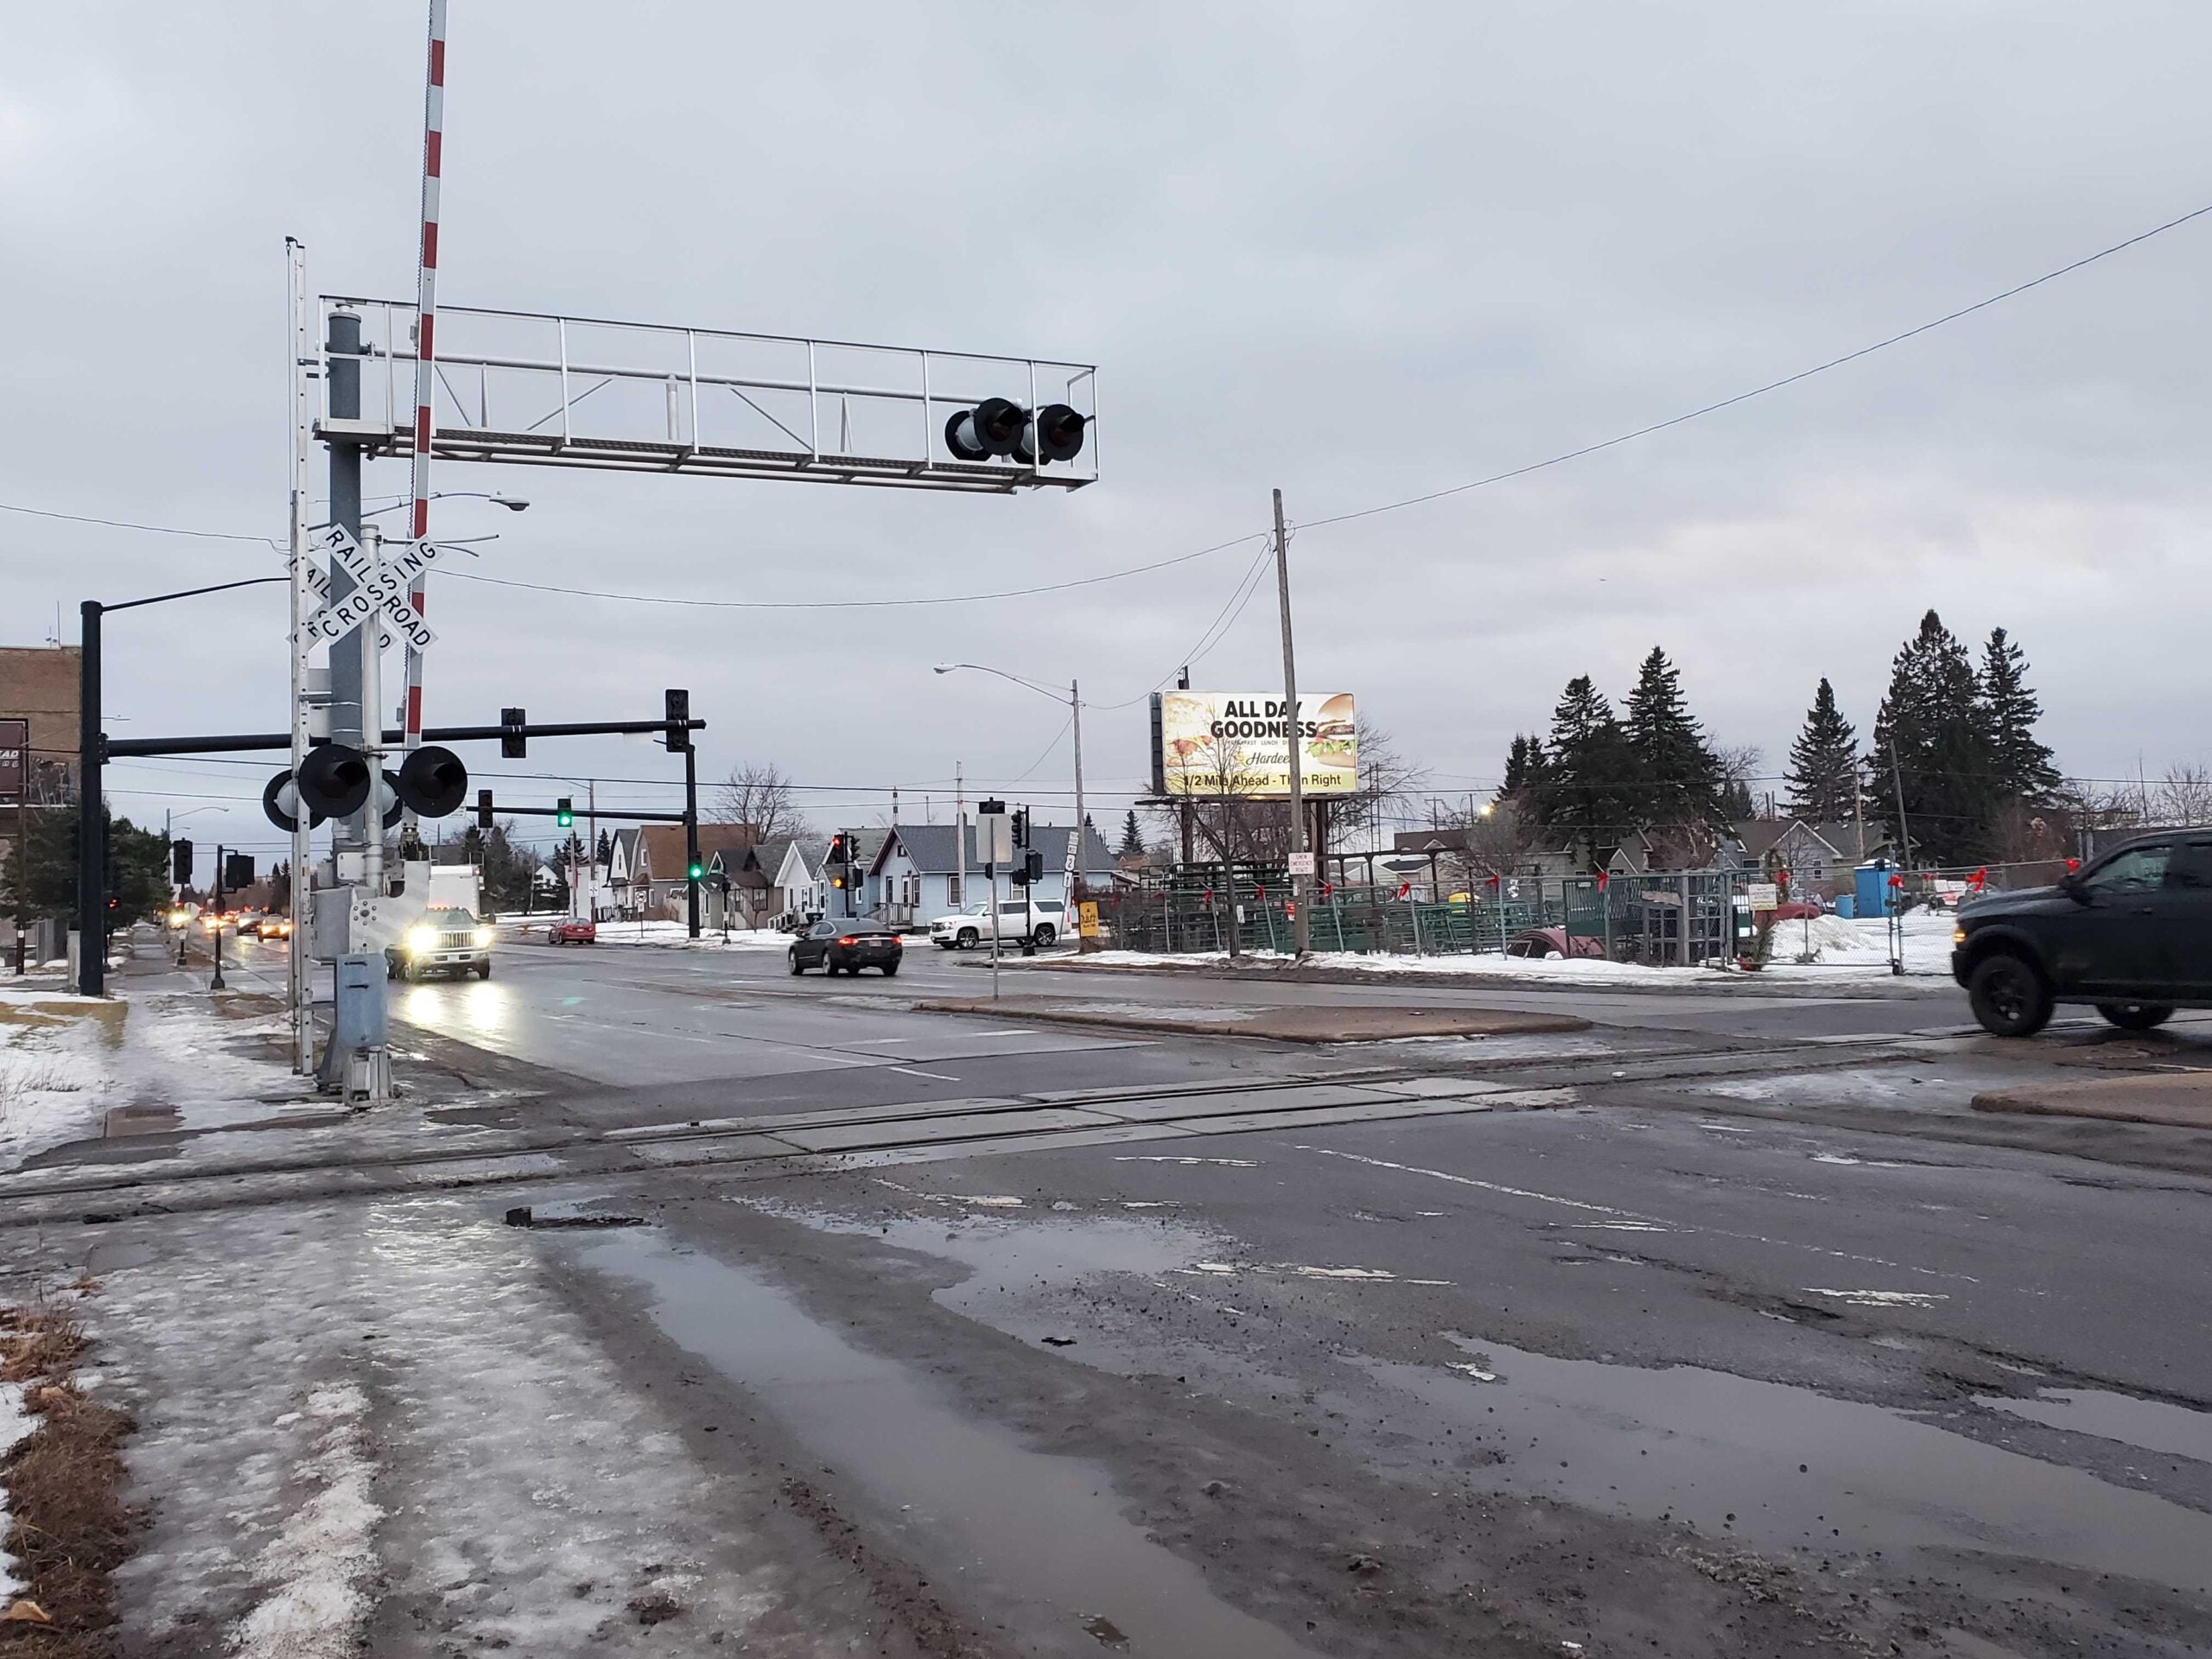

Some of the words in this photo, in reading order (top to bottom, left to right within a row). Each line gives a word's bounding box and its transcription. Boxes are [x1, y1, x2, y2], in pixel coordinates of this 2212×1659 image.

[322, 542, 436, 638] CROSSING
[325, 529, 372, 583] RAIL
[383, 594, 431, 647] ROAD
[1224, 701, 1260, 718] ALL
[1211, 721, 1319, 739] GOODNESS
[1246, 752, 1291, 766] Hardee
[1232, 774, 1269, 786] Ahead
[1311, 774, 1341, 787] Right
[1067, 858, 1072, 868] 2
